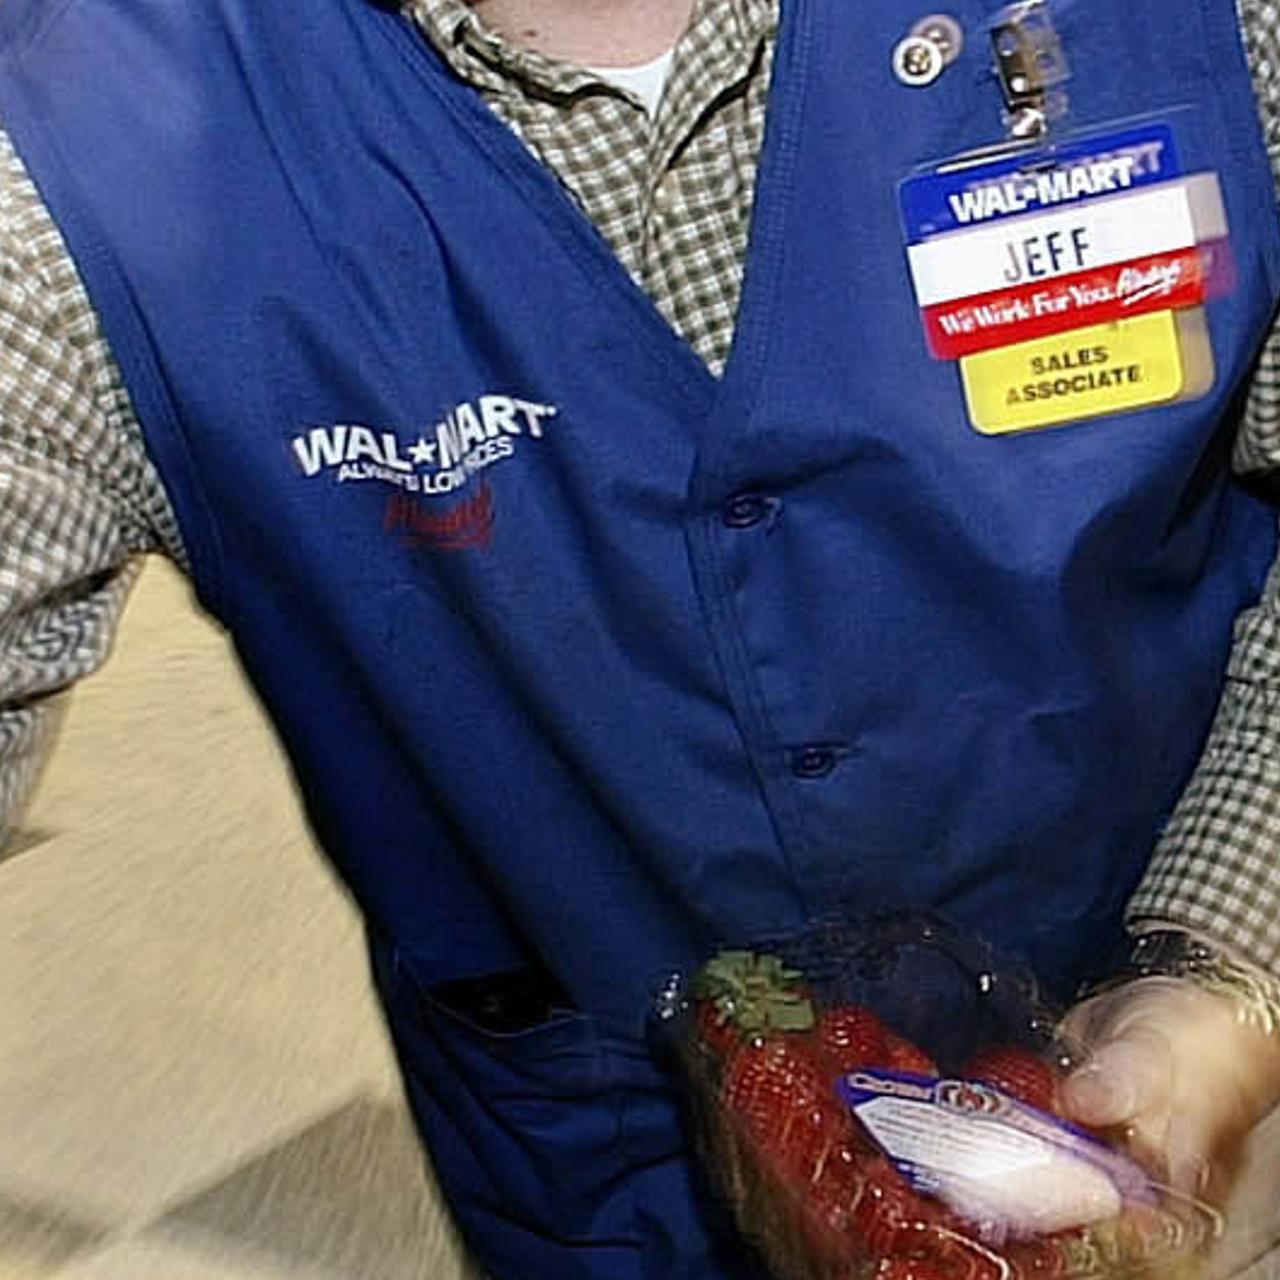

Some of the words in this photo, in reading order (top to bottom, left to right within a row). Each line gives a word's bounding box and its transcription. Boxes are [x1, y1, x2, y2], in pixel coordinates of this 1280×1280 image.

[1003, 226, 1091, 282] JEFF
[1032, 290, 1071, 317] For
[1030, 346, 1109, 376] SALES
[1005, 365, 1142, 407] ASSOCIATE
